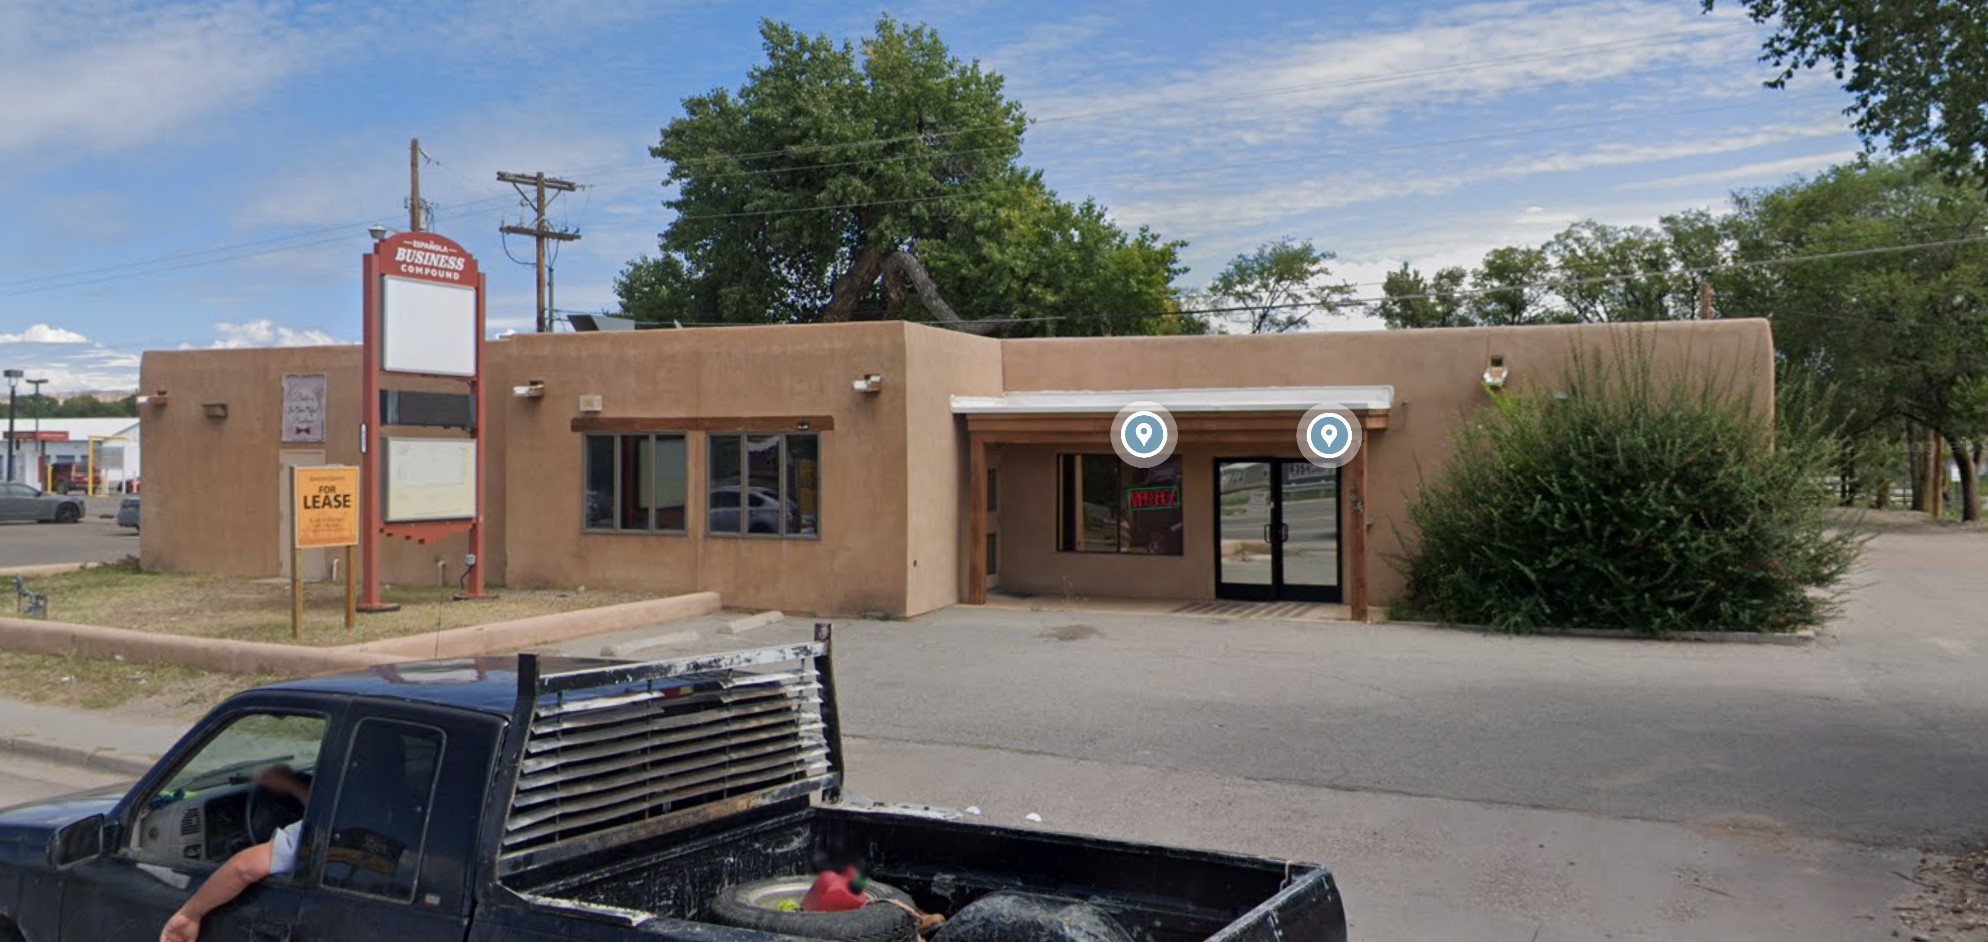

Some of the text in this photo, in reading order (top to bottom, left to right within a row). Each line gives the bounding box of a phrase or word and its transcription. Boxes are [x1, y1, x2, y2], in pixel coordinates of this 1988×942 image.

[412, 240, 449, 253] ESPAÑOLA
[395, 247, 465, 271] BUSINESS
[401, 264, 460, 280] COMPOUND
[318, 485, 336, 494] FOR
[303, 494, 351, 509] LEASE
